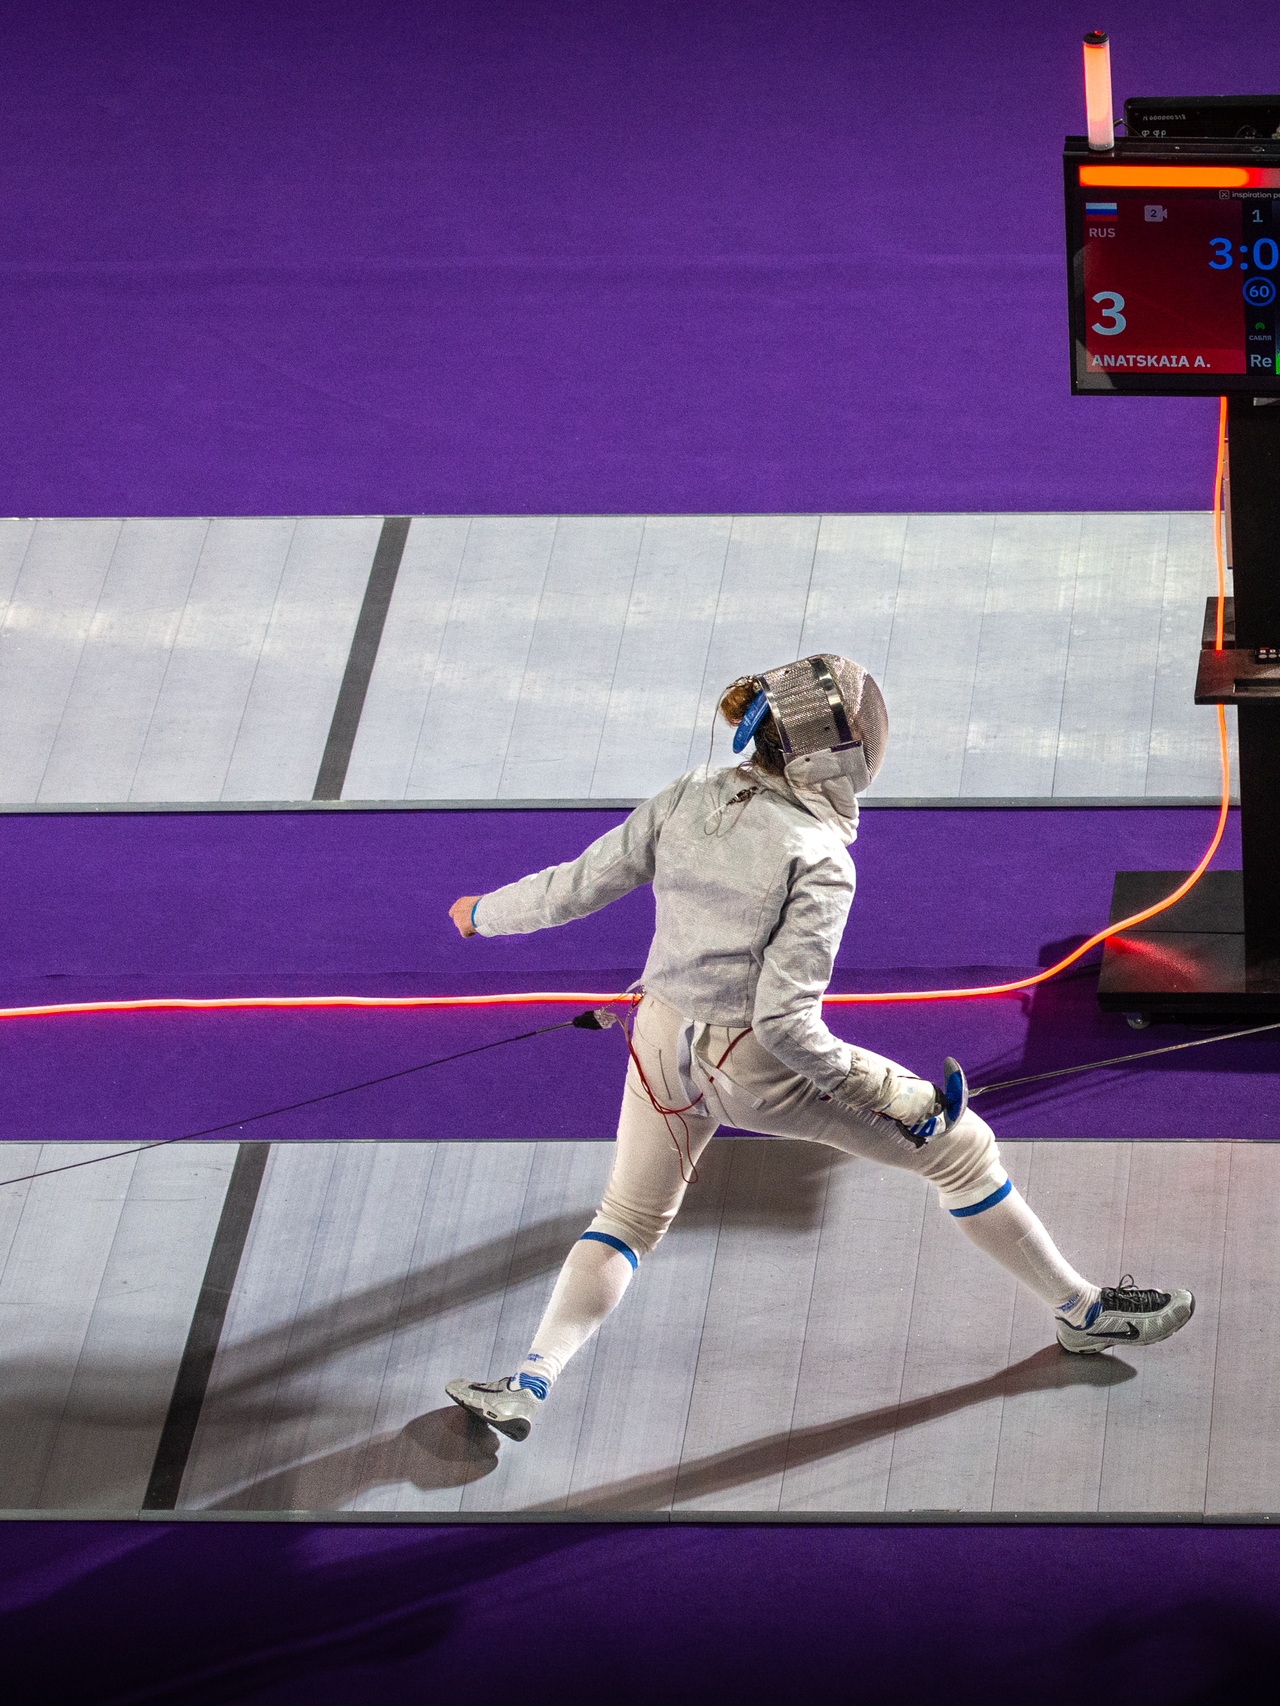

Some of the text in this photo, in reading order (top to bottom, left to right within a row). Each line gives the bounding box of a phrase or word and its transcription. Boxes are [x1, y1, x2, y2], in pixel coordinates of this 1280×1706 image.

[1231, 191, 1272, 199] inspiration
[1149, 209, 1158, 218] 2
[1252, 209, 1263, 223] 1
[1089, 228, 1116, 238] RUS
[1249, 285, 1270, 298] 60
[1091, 291, 1127, 336] 3
[1091, 354, 1211, 368] ANATSKAIA A.
[1250, 354, 1273, 368] Re
